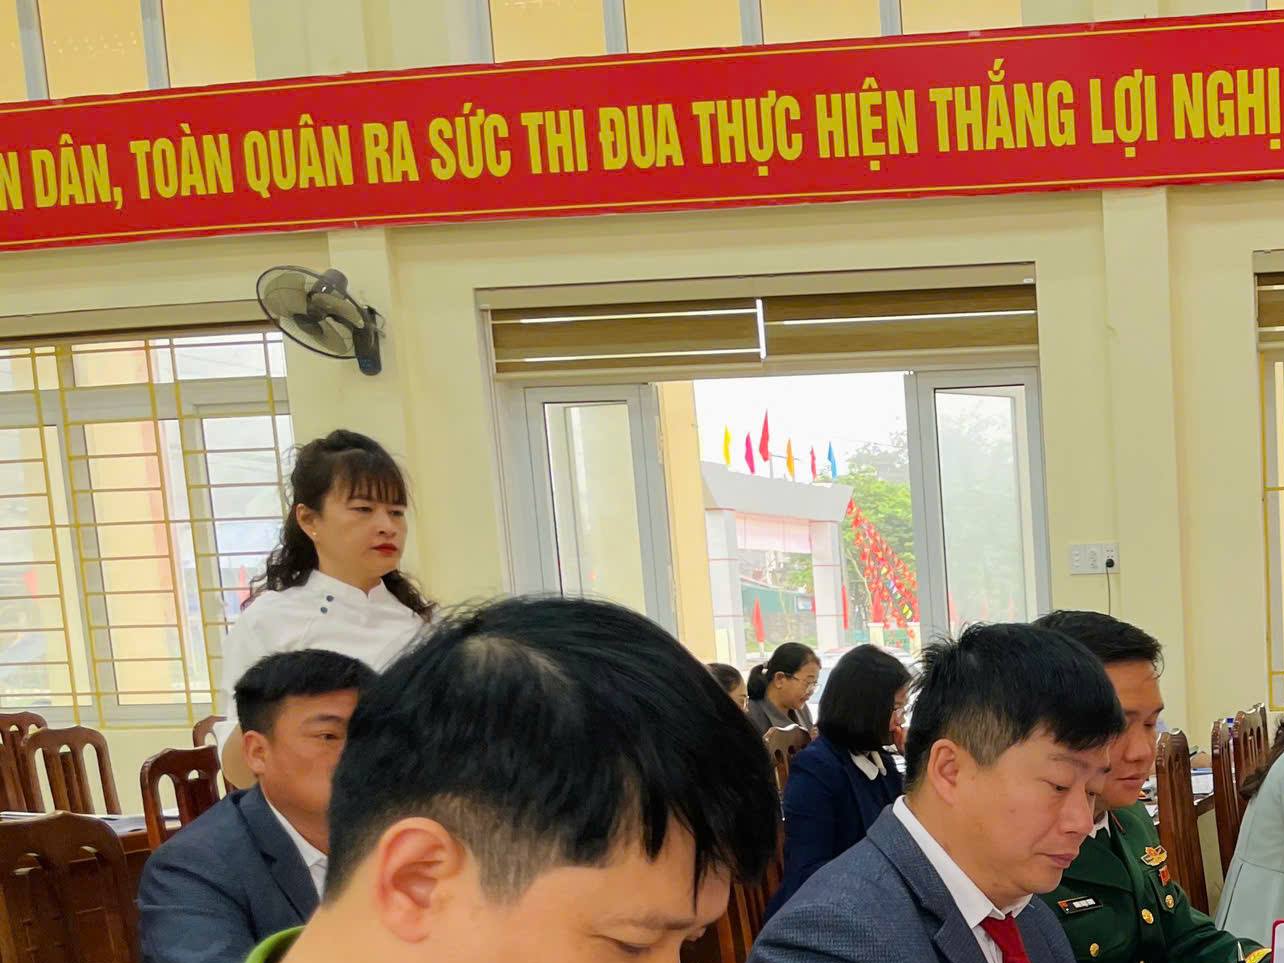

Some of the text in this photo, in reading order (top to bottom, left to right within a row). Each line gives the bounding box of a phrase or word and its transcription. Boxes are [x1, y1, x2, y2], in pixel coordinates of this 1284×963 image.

[31, 133, 123, 210] DÂN,
[130, 123, 234, 200] TOÀN
[243, 113, 354, 199] QUÂN
[363, 120, 420, 184] RA
[428, 102, 512, 181] SỨC
[521, 109, 589, 174] THI
[598, 103, 685, 170] ĐUA
[692, 90, 803, 177] THỰC
[815, 77, 919, 171] HIỆN
[929, 58, 1076, 152] THẮNG
[1089, 68, 1158, 158] LỢI
[1173, 67, 1281, 150] NGHỊ
